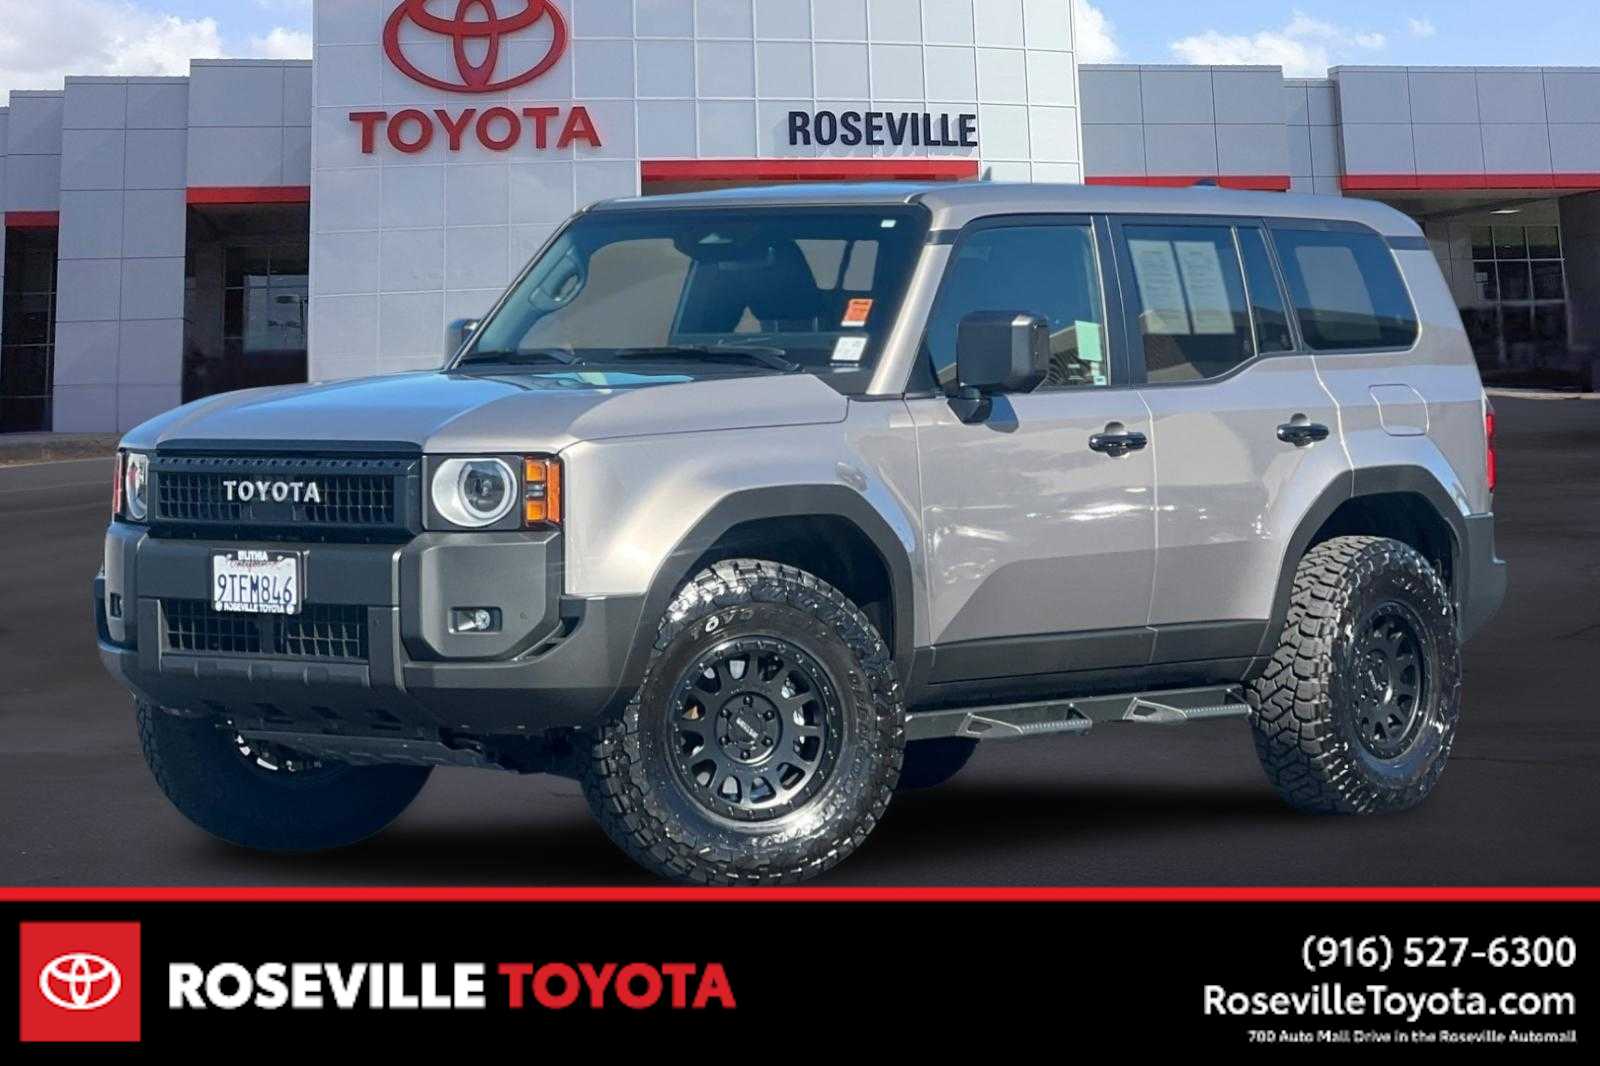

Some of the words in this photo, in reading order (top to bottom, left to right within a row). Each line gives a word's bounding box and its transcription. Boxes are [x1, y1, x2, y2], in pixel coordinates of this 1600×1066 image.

[349, 105, 602, 154] TOYOTA
[788, 110, 978, 147] ROSEVILLE
[222, 480, 321, 504] TOYOTA
